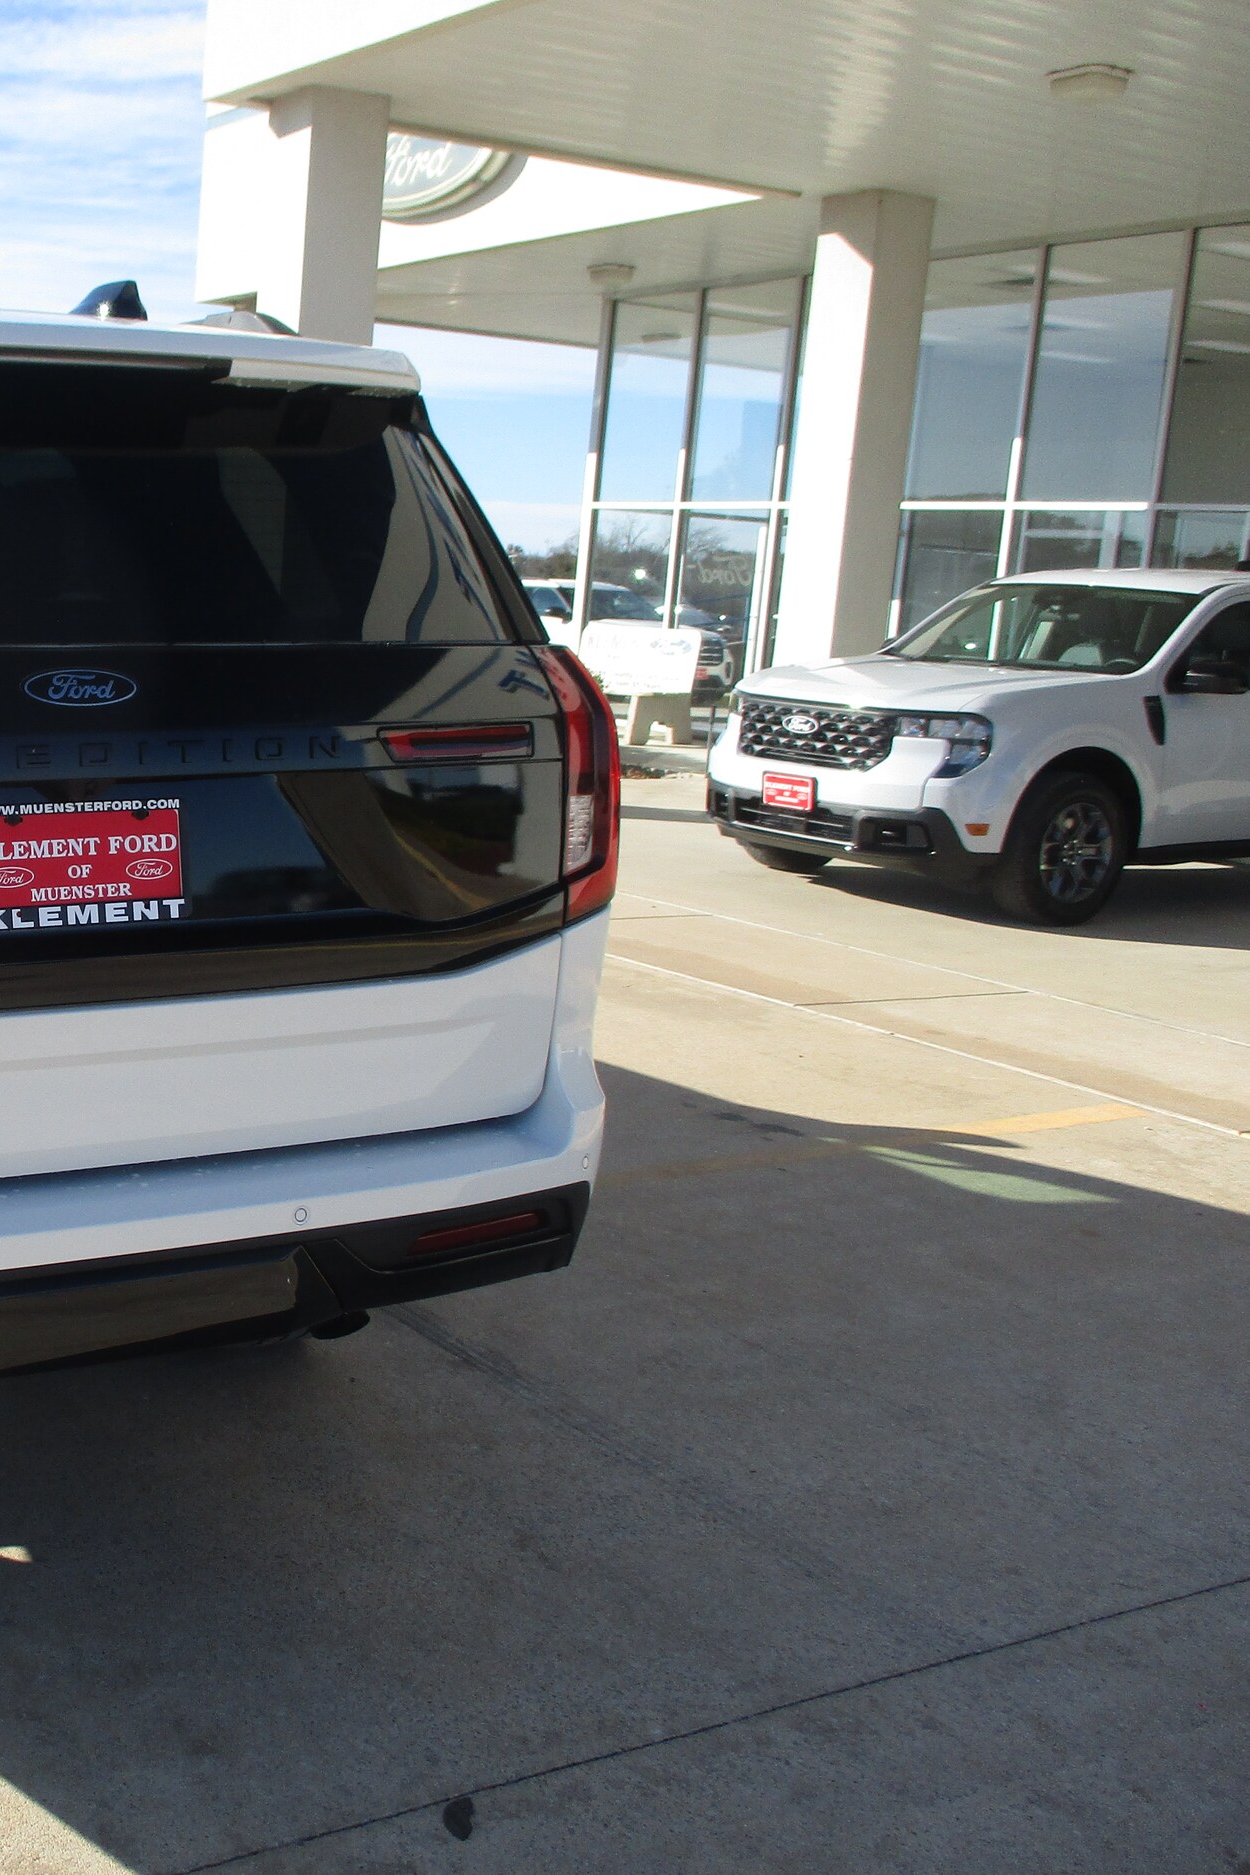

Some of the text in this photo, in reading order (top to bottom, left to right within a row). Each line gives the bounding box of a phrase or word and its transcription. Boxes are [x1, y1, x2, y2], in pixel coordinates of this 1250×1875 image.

[48, 673, 116, 700] Ford
[108, 833, 178, 855] FORD
[67, 864, 93, 879] OF
[134, 861, 164, 877] Ford
[30, 882, 133, 903] MUENSTER
